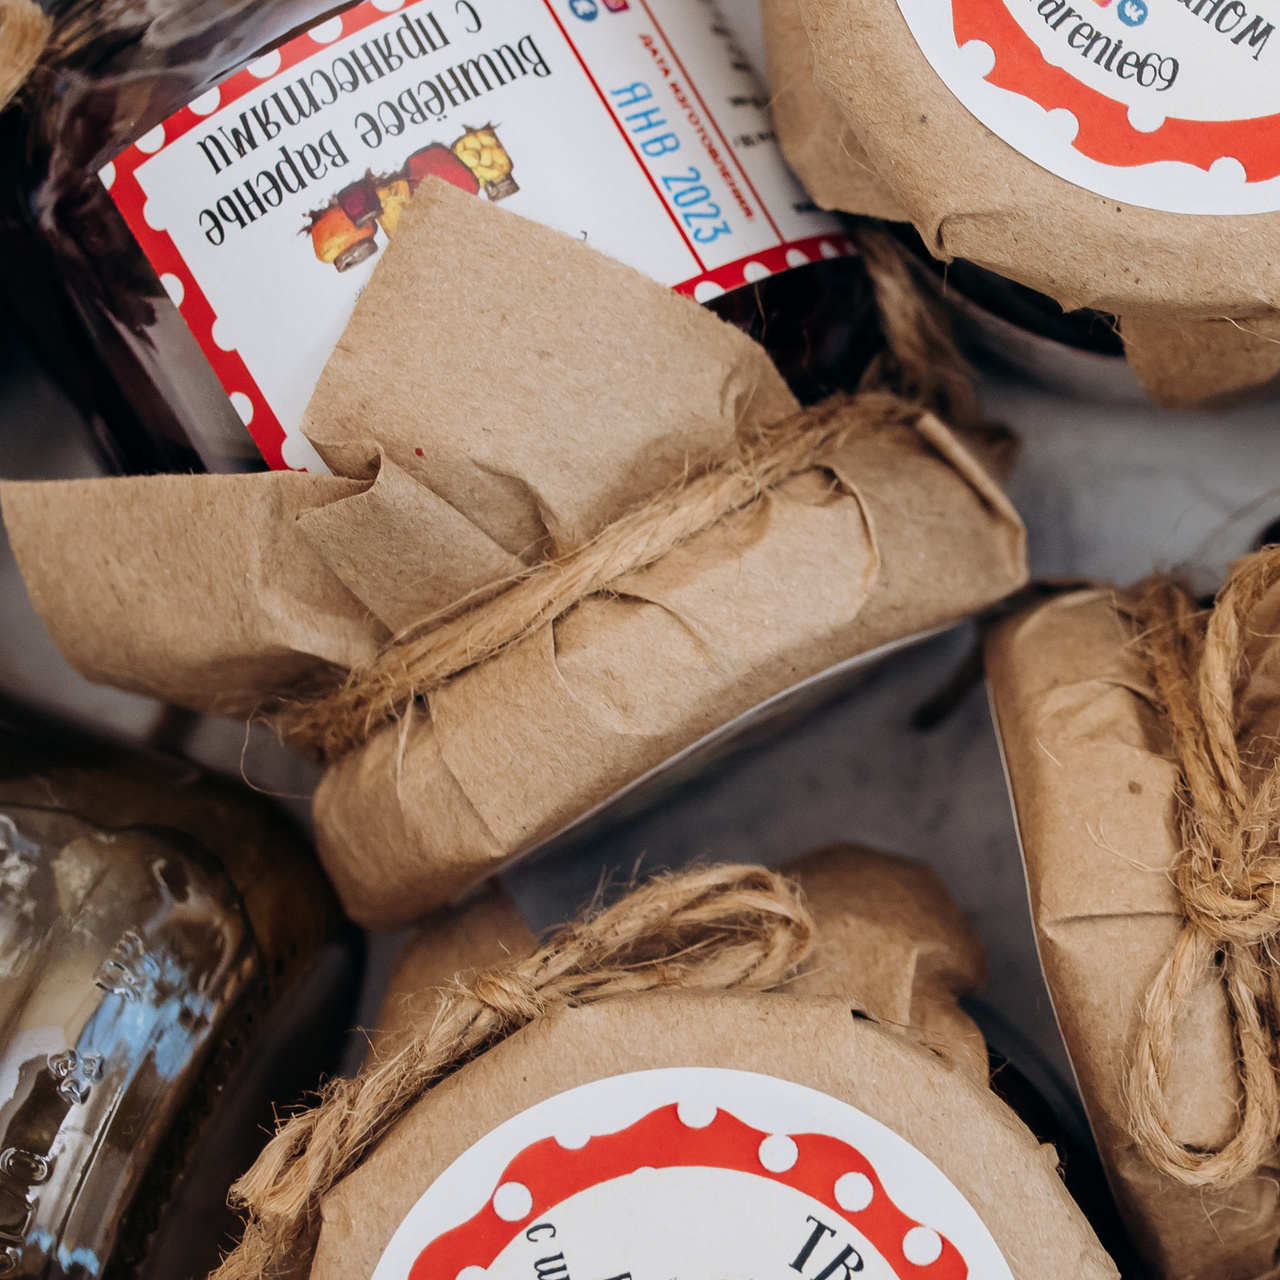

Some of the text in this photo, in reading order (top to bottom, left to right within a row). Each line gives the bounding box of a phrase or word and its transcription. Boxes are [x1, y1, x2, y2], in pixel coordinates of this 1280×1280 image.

[195, 0, 483, 176] с пряностями
[198, 34, 553, 247] Вишнёвое варенье
[609, 81, 732, 245] ЯНВ 2023
[525, 1222, 557, 1243] с
